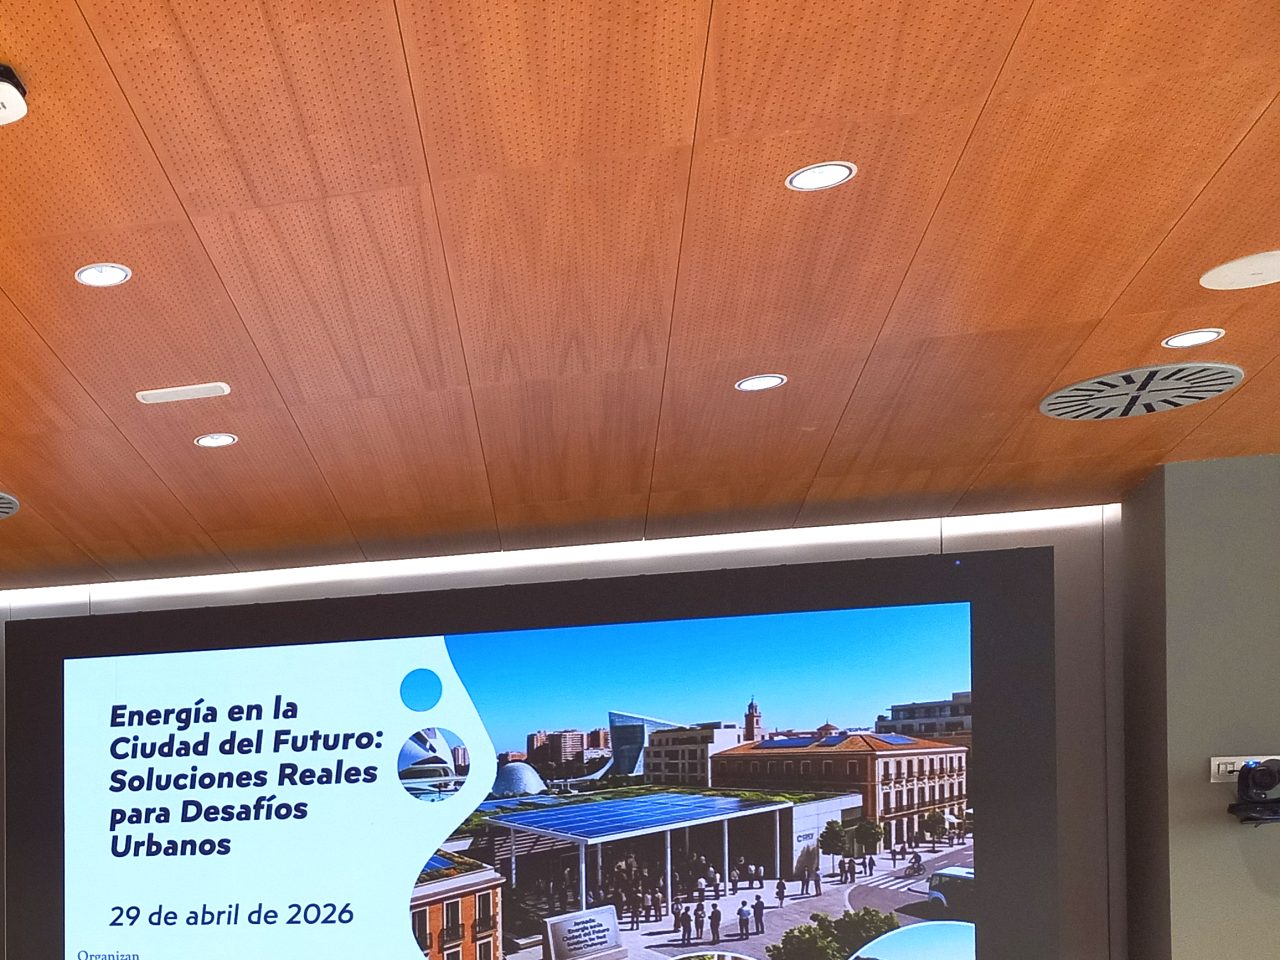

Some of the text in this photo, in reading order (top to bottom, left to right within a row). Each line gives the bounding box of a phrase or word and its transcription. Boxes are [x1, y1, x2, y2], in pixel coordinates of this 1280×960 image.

[110, 695, 297, 730] Energía en la
[110, 730, 383, 759] Ciudad del Futuro:
[109, 759, 378, 792] Soluciones Reales
[109, 795, 308, 831] para Desafíos
[111, 833, 230, 857] Urbanos
[109, 903, 353, 926] 29 de abril de 2026
